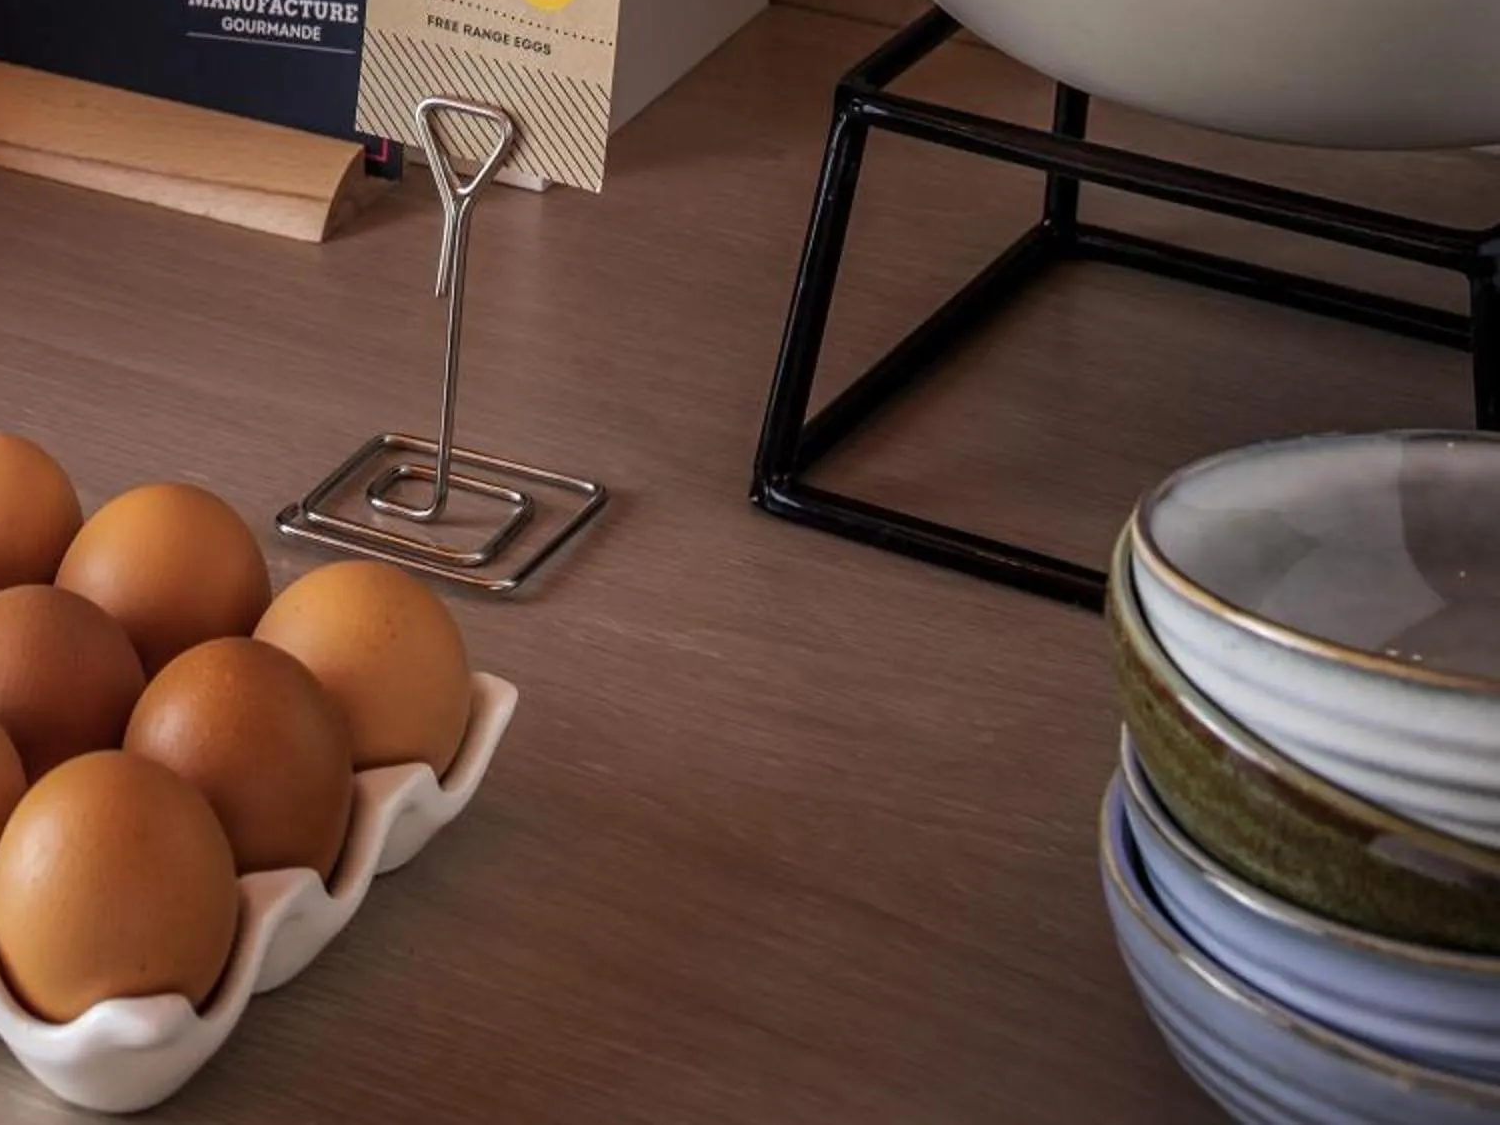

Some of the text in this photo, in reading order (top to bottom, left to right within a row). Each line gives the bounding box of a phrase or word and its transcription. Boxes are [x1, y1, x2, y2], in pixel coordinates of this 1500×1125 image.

[221, 16, 321, 41] GOURMANDE
[427, 14, 552, 56] FREE RANGE EGGS
